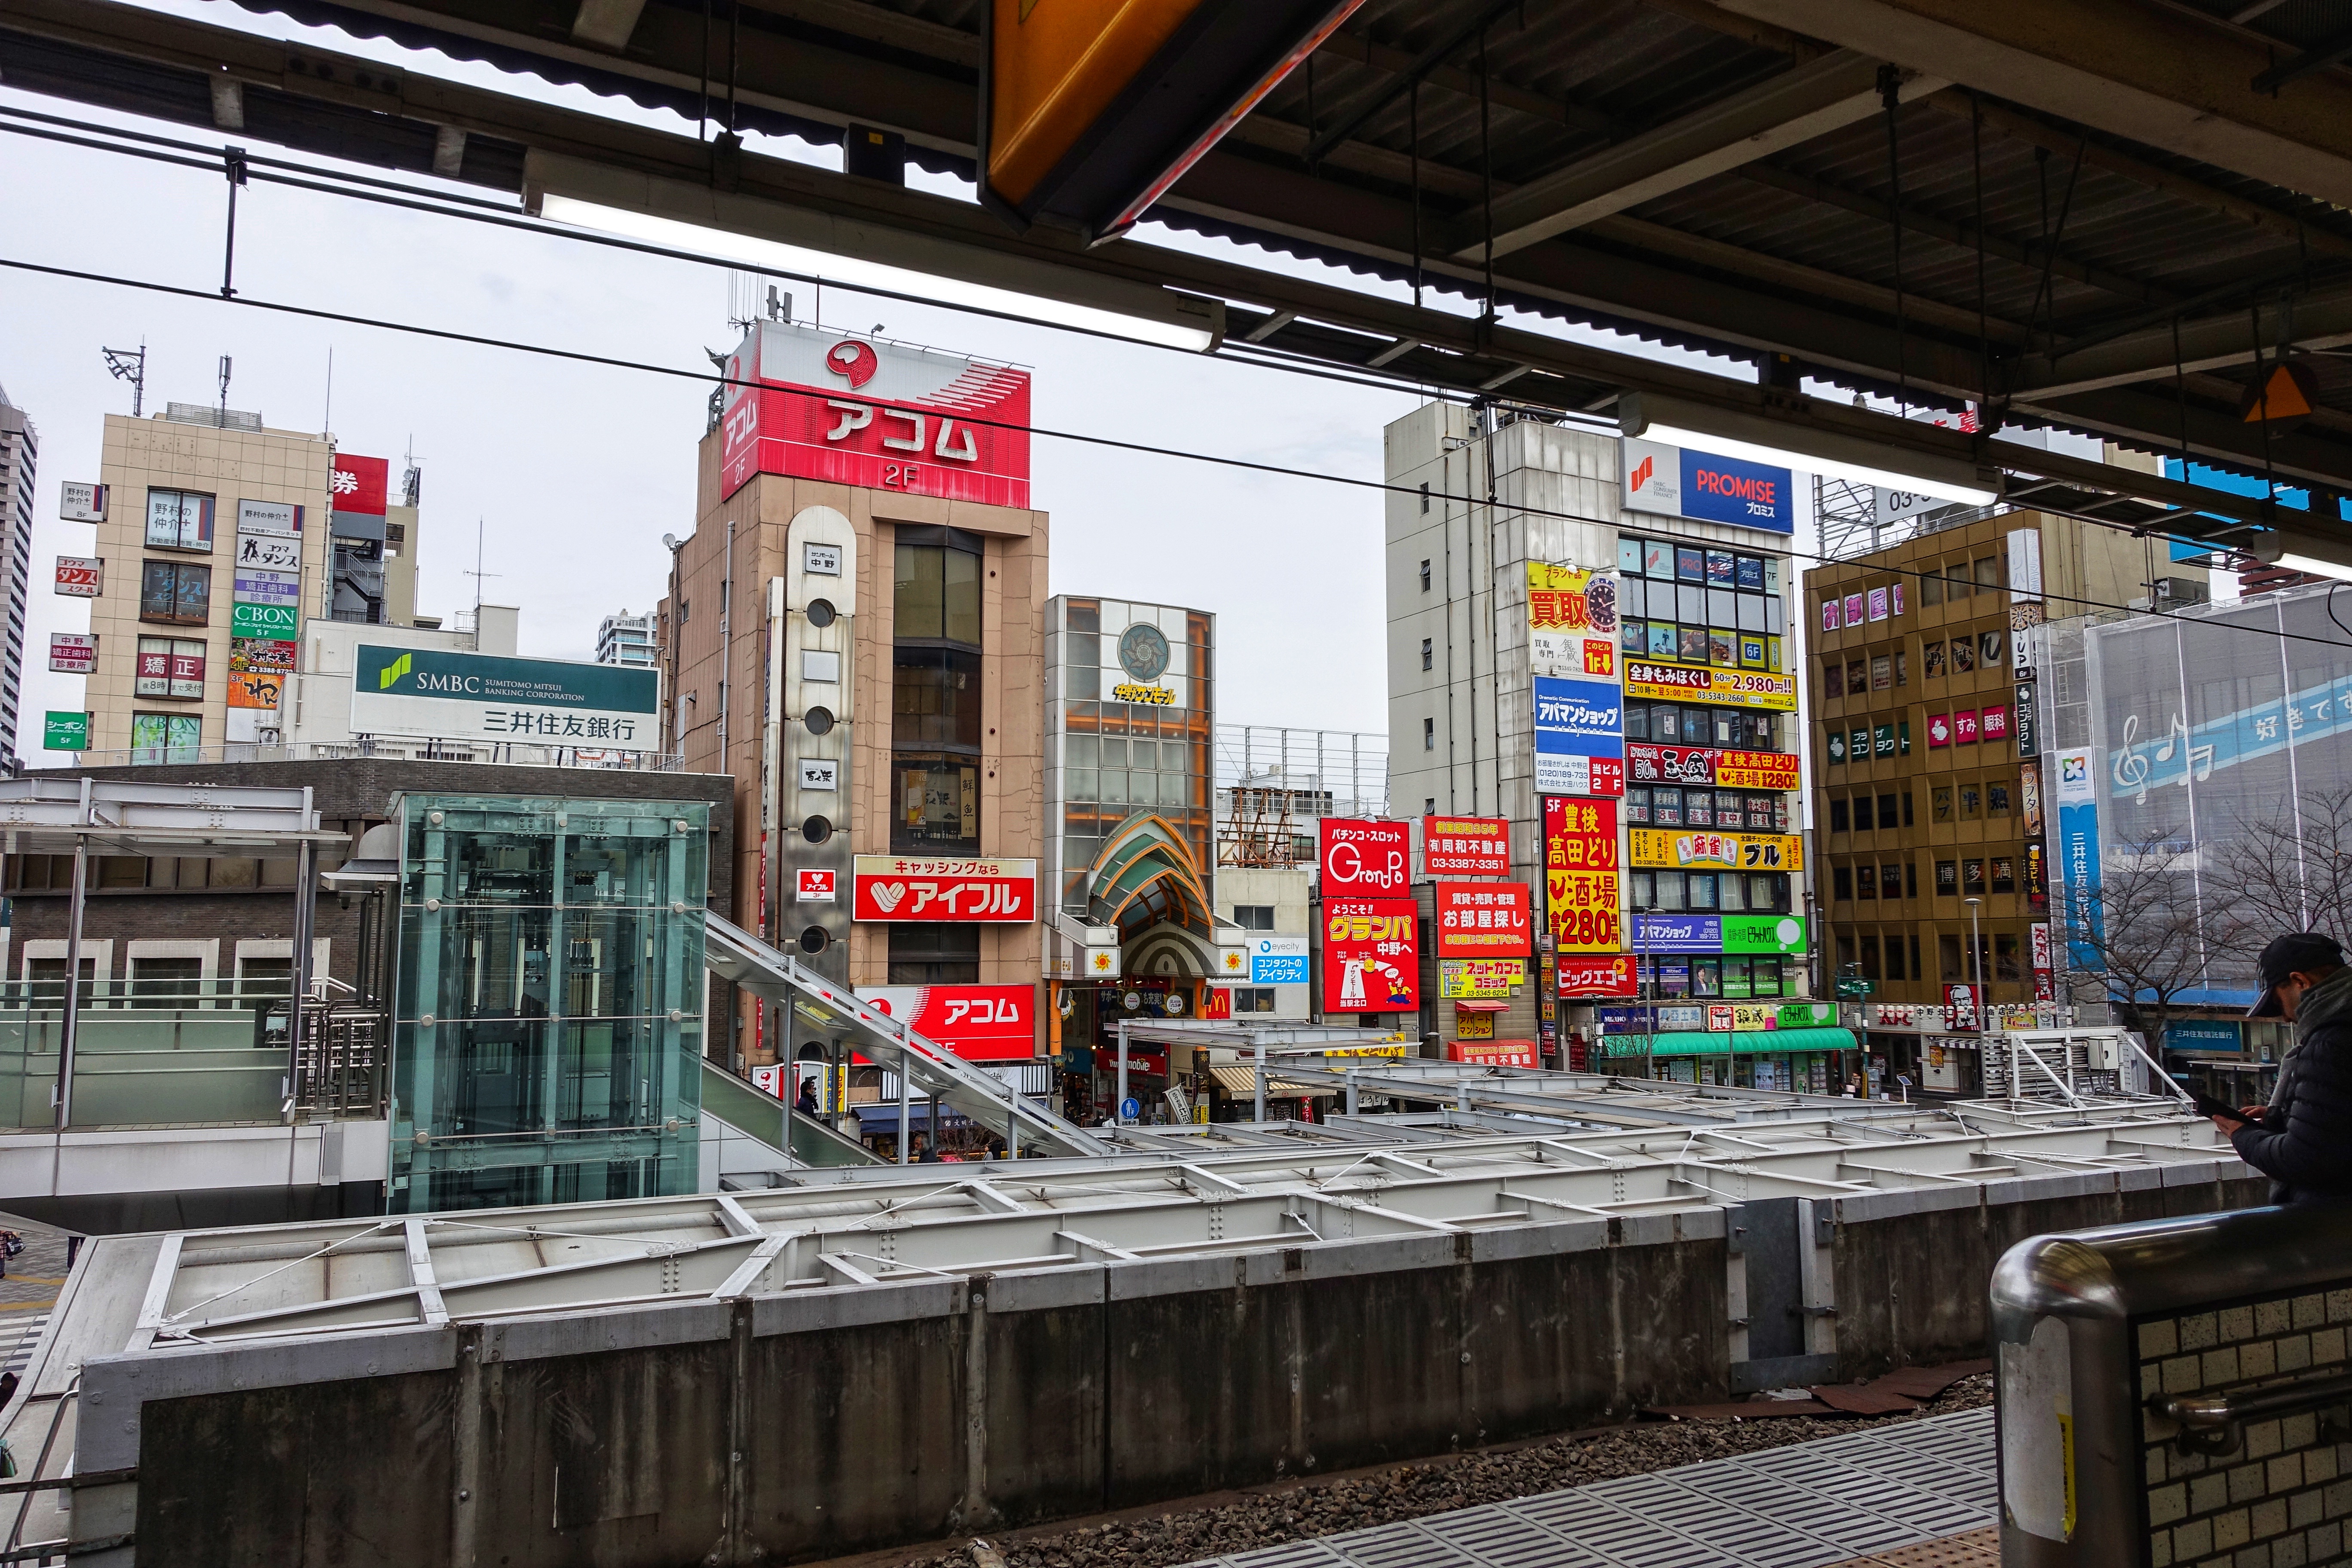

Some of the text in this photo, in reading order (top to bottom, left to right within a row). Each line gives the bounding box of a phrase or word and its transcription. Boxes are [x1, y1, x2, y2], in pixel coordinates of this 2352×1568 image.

[726, 398, 757, 457] アコム
[827, 398, 978, 462] アコム
[735, 457, 745, 485] 2F
[885, 464, 918, 487] 2F
[67, 487, 91, 496] 野村の
[1653, 486, 1678, 494] CONSUMER
[1697, 469, 1775, 504] PROMISE
[154, 503, 192, 516] 野村の
[1746, 502, 1775, 518] プロミス
[240, 527, 300, 537] 野村不動産アーバンネット
[267, 544, 290, 553] コウマ
[59, 559, 85, 567] コウマ
[261, 553, 298, 567] ダンス
[811, 558, 835, 568] 中野
[58, 569, 97, 584] ダンス
[256, 572, 280, 582] 中野
[1766, 572, 1777, 581] 7F
[66, 585, 95, 594] スクール
[245, 581, 289, 594] 矯正歯科
[250, 593, 283, 604] 診療所
[1528, 590, 1590, 629] 買取
[61, 637, 84, 646] 中野
[1534, 639, 1550, 649] 買取
[1586, 642, 1611, 651] このビル
[52, 647, 92, 658] 矯正歯科
[1539, 649, 1554, 659] 専門
[1746, 646, 1760, 657] 6F
[55, 659, 87, 670] 診療所
[145, 656, 195, 676] 矯正
[1585, 652, 1601, 673] 1F
[231, 674, 243, 682] 3F
[1629, 665, 1711, 686] 全身もみほぐし
[417, 672, 480, 693] SMBC
[485, 679, 562, 691] SUMITOMO MITSUI
[484, 687, 585, 701] BANKING CORPORATION
[1113, 683, 1176, 705] 中野サンモール
[1697, 691, 1745, 703] 03-5343-2660
[1539, 702, 1618, 726] アパマンショップ
[484, 710, 635, 741] 三井住友銀行
[1704, 750, 1713, 760] 4F
[1721, 751, 1796, 771] 豊後高田どり
[1537, 769, 1589, 779] (0120)189-733
[1592, 763, 1621, 776] 当ビル
[1538, 778, 1589, 789] 株式会社大田ハウス
[1732, 770, 1761, 787] 酒場
[1767, 772, 1792, 789] 280
[1547, 799, 1561, 812] 5F
[1563, 803, 1600, 833] 豊後
[1435, 821, 1499, 835] 創業昭和35年
[1332, 828, 1401, 843] パチンコ・スロット
[1740, 835, 1782, 843] 全国チェーンの店
[1548, 834, 1616, 867] 高田どり
[1694, 835, 1721, 856] 麻雀
[1743, 843, 1781, 868] ブル
[894, 860, 999, 875] キャッシングなら
[1431, 858, 1504, 870] 03-3387-3351
[909, 882, 1021, 914] アイフル
[1567, 874, 1617, 909] 酒場
[1443, 910, 1525, 928] お部屋探し
[1329, 915, 1412, 941] グランパ
[1561, 909, 1611, 945] 280
[1445, 934, 1525, 945] お気軽にご相談下さい。
[1272, 942, 1299, 952] eyecity
[1377, 941, 1413, 956] 中野へ
[1258, 959, 1302, 968] コンタクトの
[1466, 961, 1522, 976] ネットカフェ
[1258, 969, 1302, 981] アイシティ
[1558, 969, 1627, 988] ビッグエコー
[1473, 976, 1508, 989] コミック
[1339, 999, 1367, 1008] 当駅北口
[945, 998, 1020, 1025] アコム
[1459, 1026, 1491, 1035] マンション
